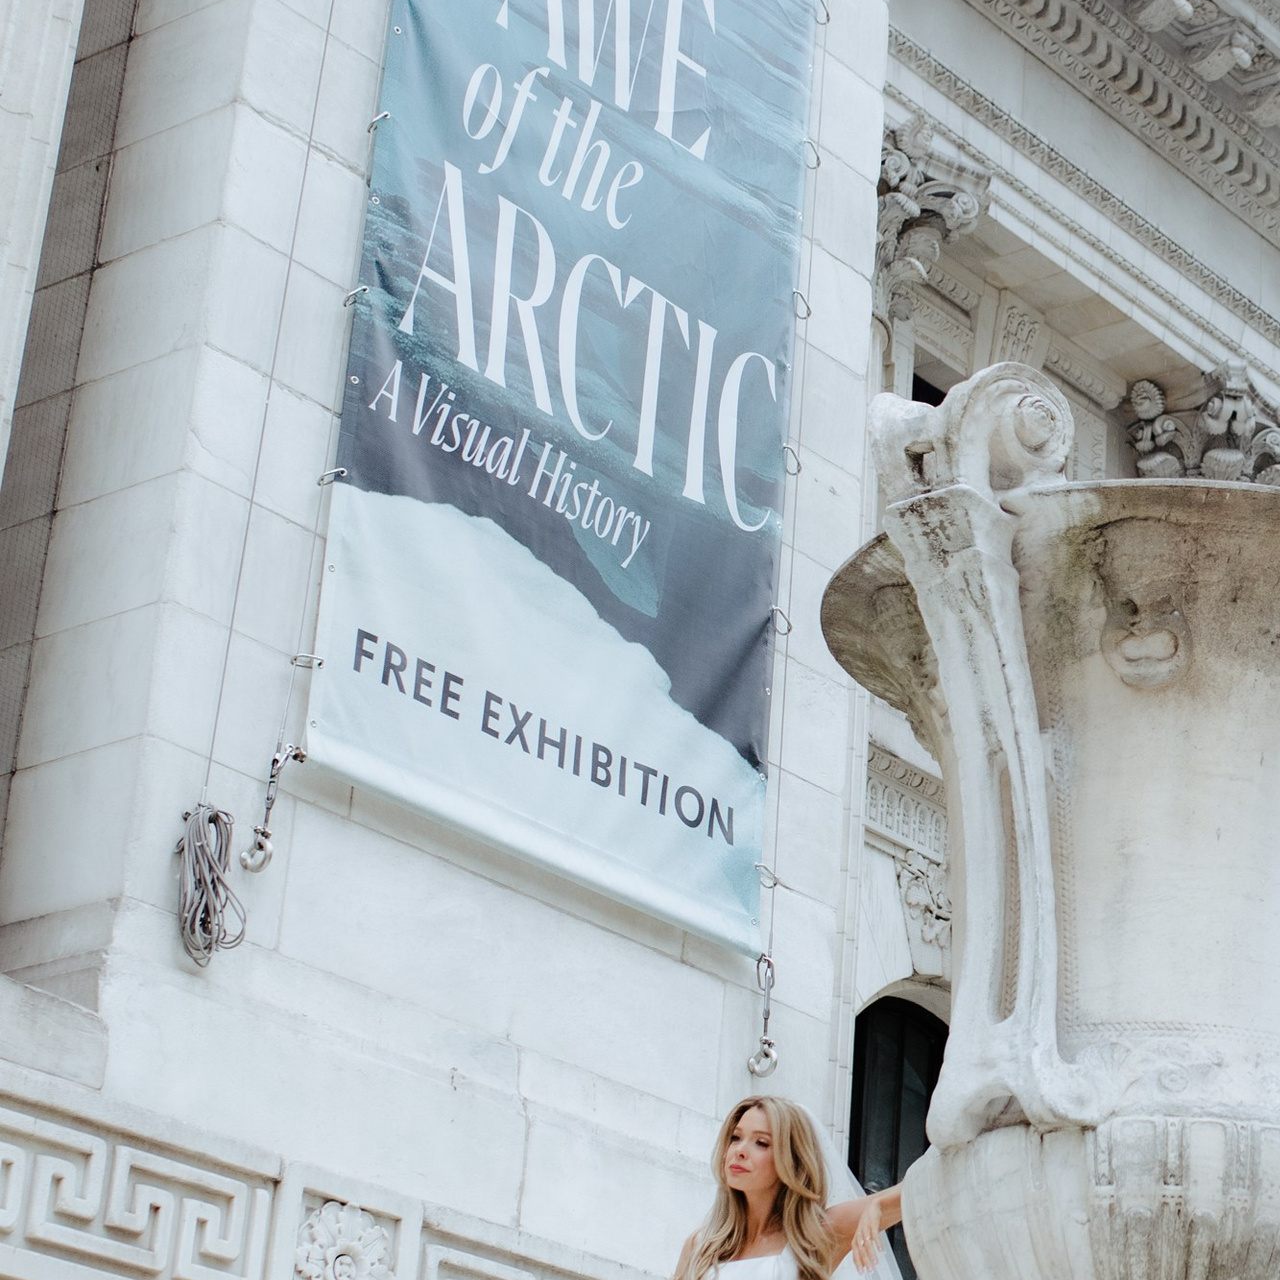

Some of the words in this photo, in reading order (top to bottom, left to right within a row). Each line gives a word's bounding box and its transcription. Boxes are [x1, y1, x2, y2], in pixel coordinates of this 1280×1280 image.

[462, 63, 550, 174] of
[538, 100, 644, 230] the
[399, 160, 777, 532] ARCTIC
[369, 359, 403, 422] A
[412, 372, 530, 486] Visual
[528, 442, 651, 568] History
[352, 628, 464, 720] FREE
[480, 690, 735, 846] EXHIBITION
